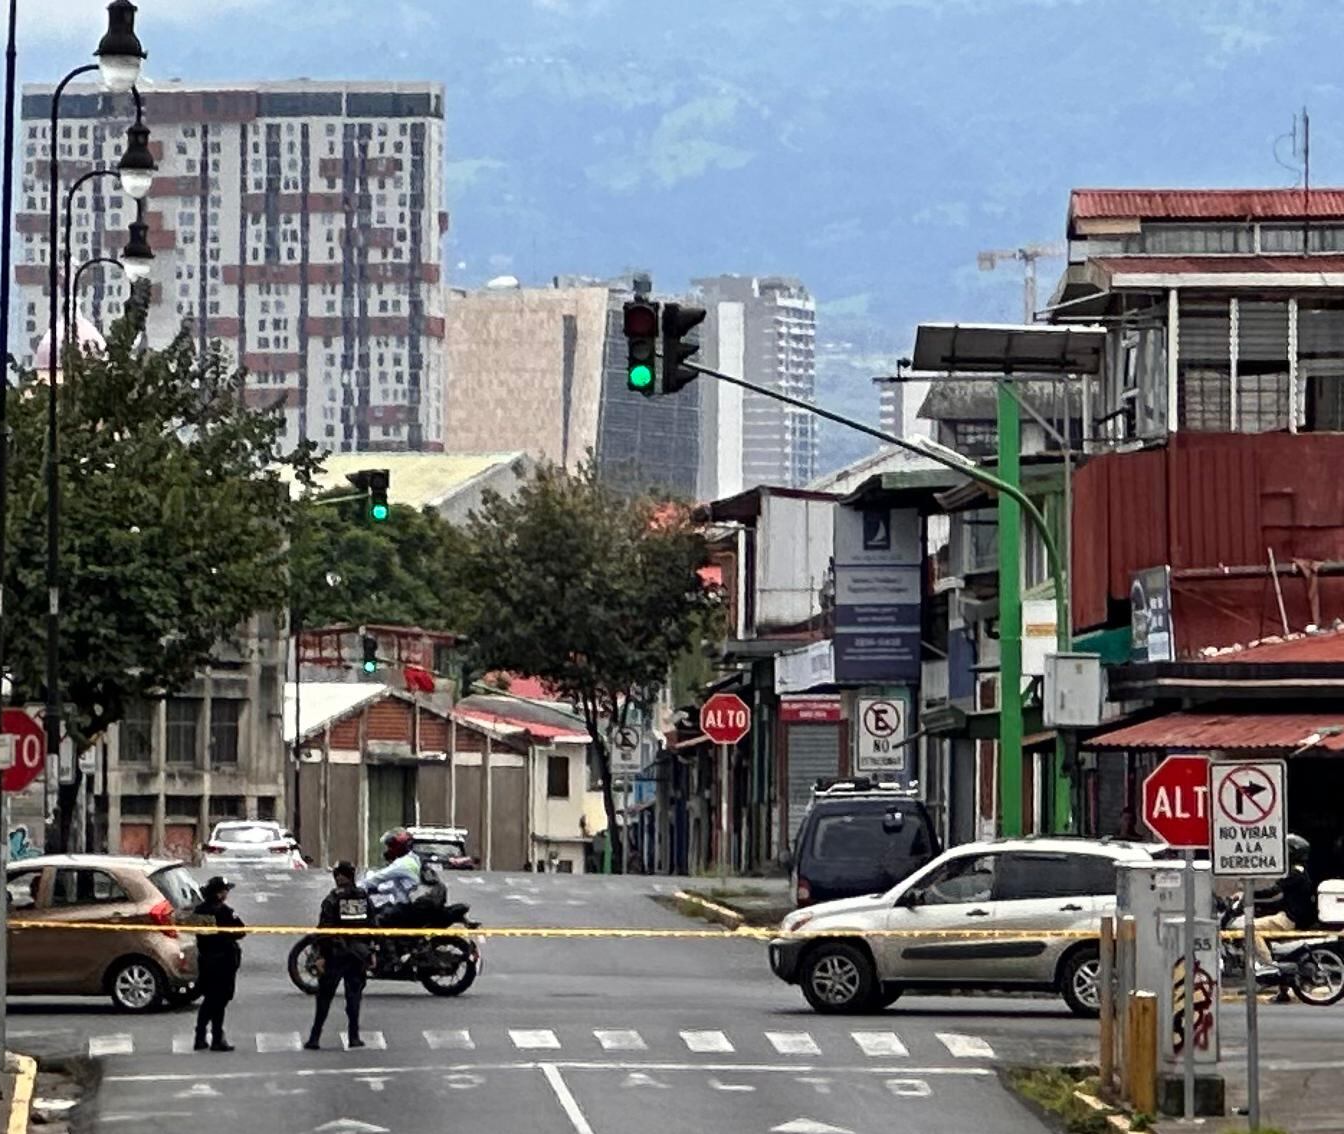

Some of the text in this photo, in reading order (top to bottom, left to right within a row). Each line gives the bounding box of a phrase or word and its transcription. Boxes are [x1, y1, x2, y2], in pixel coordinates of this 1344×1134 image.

[706, 710, 746, 728] ALTO
[873, 739, 890, 753] NO
[1152, 785, 1208, 818] ALT
[1219, 825, 1277, 839] NO VIRAR
[1234, 841, 1263, 853] A LA
[1220, 856, 1277, 869] DERECHA
